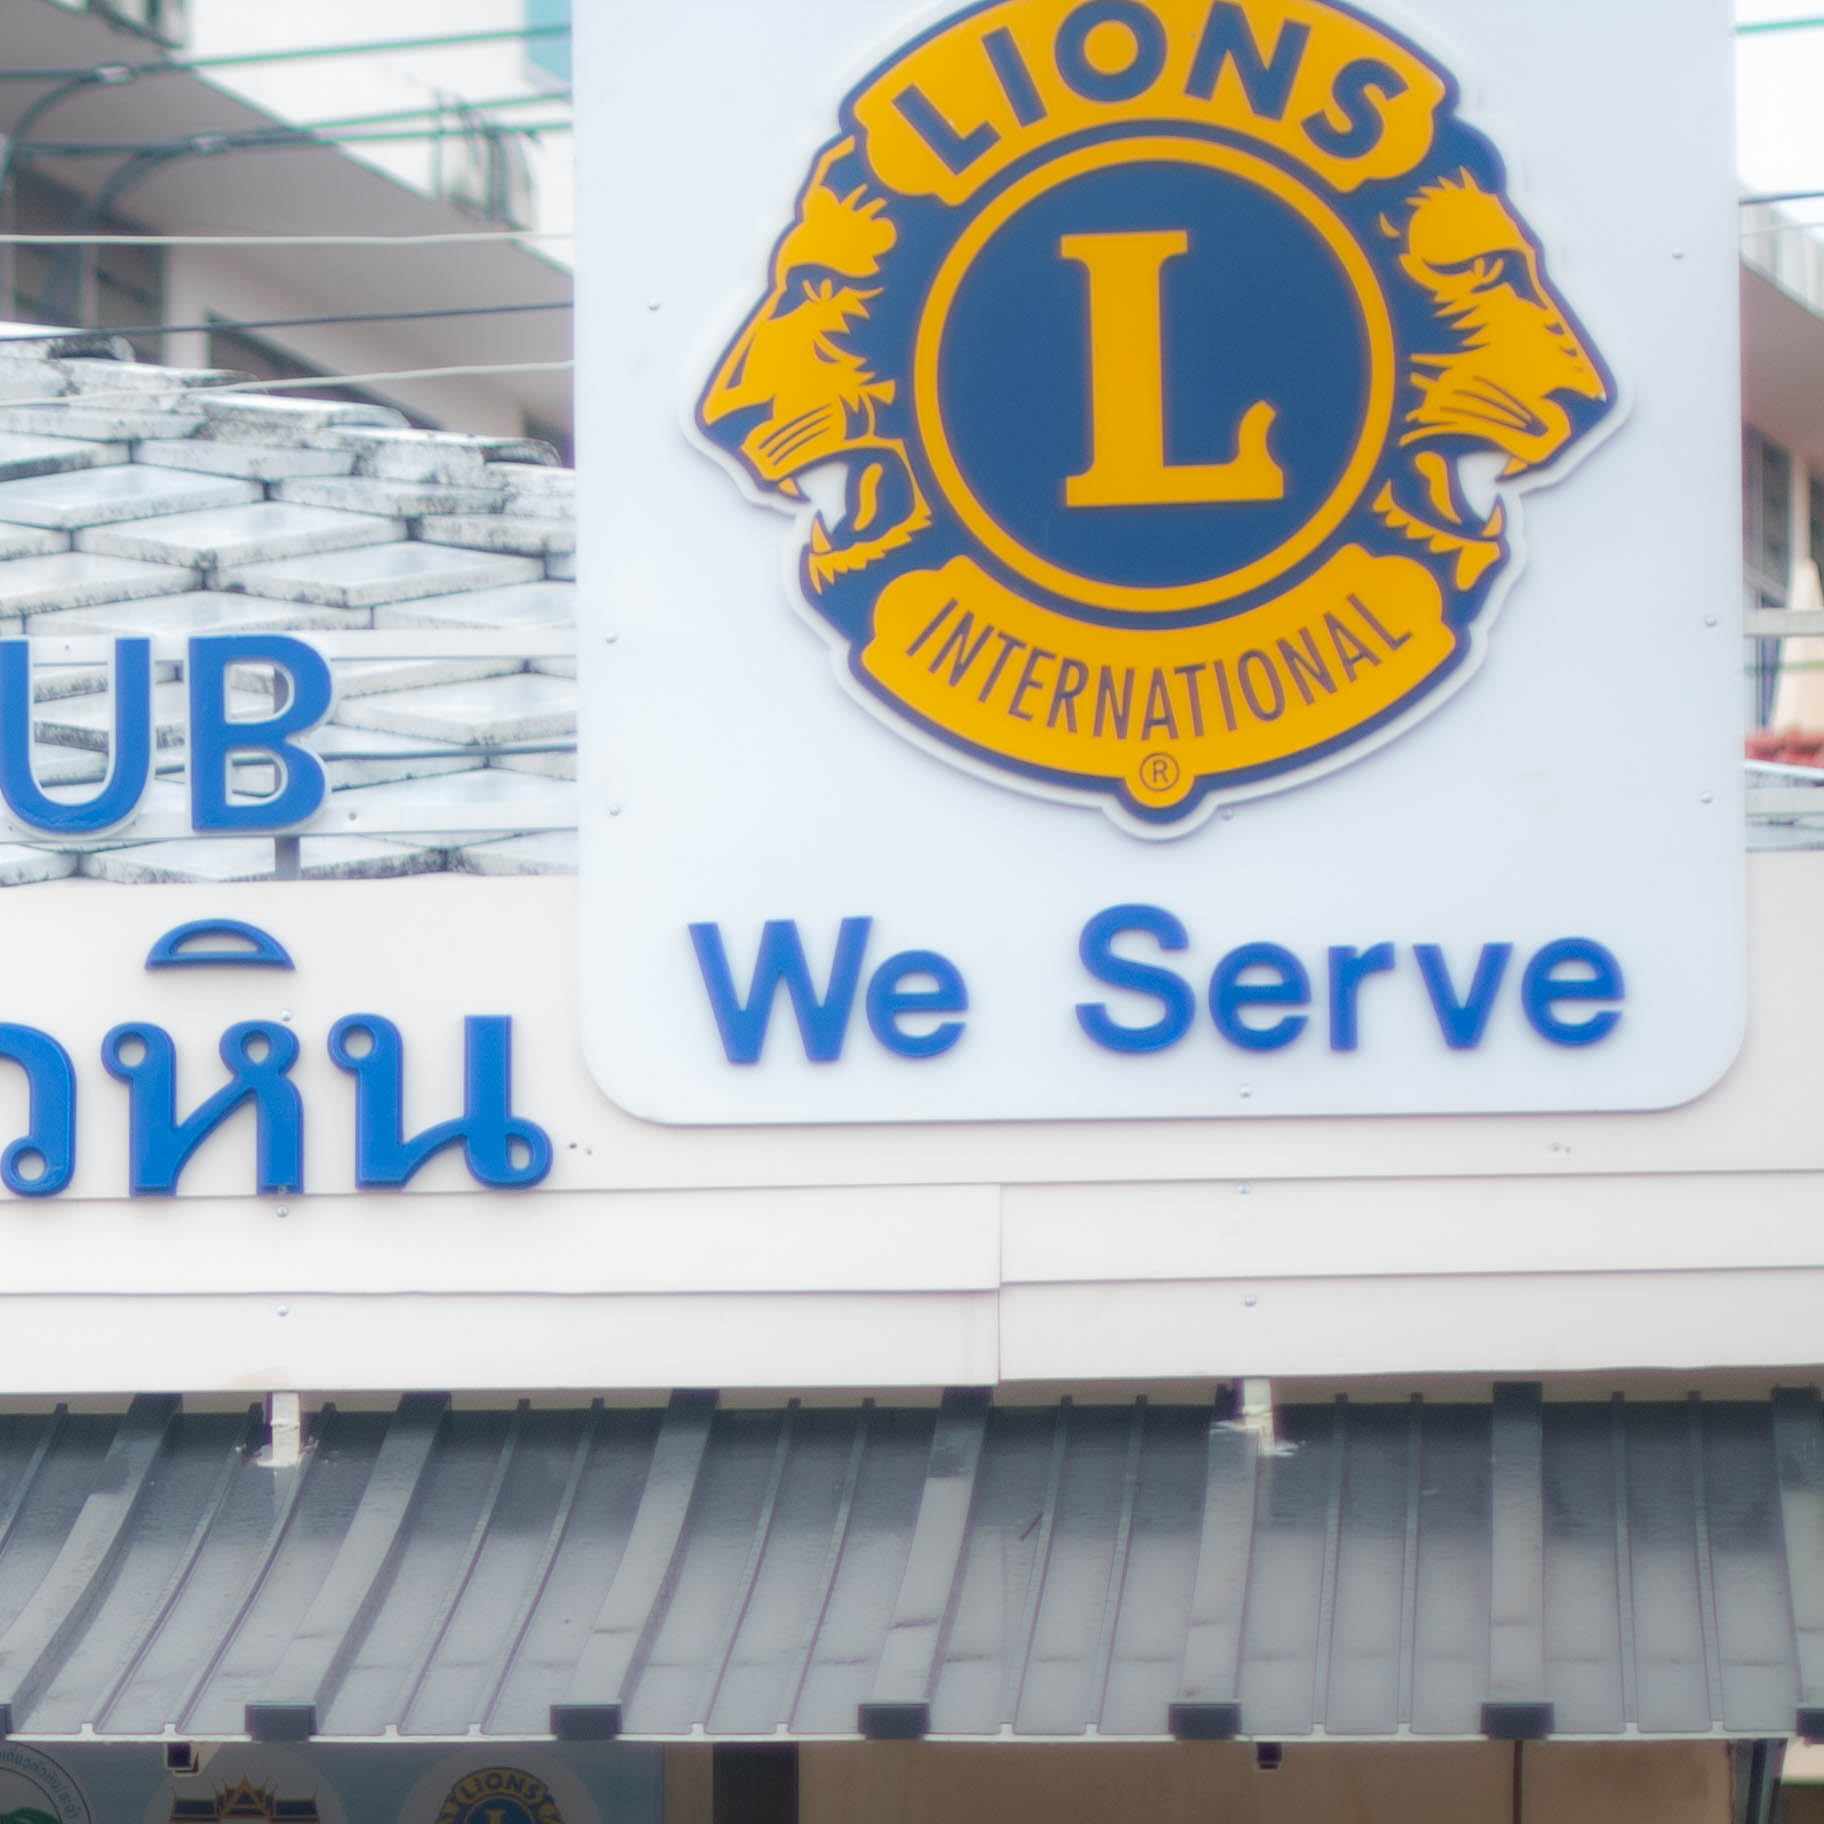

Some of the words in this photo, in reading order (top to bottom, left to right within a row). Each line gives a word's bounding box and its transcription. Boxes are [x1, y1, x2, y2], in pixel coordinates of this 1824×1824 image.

[891, 0, 1409, 178] LIONS
[1059, 229, 1285, 508] L
[905, 592, 1414, 742] INTERNATIONAL
[686, 915, 970, 1066] We
[1075, 901, 1627, 1056] Serve
[460, 1773, 546, 1800] LIONS
